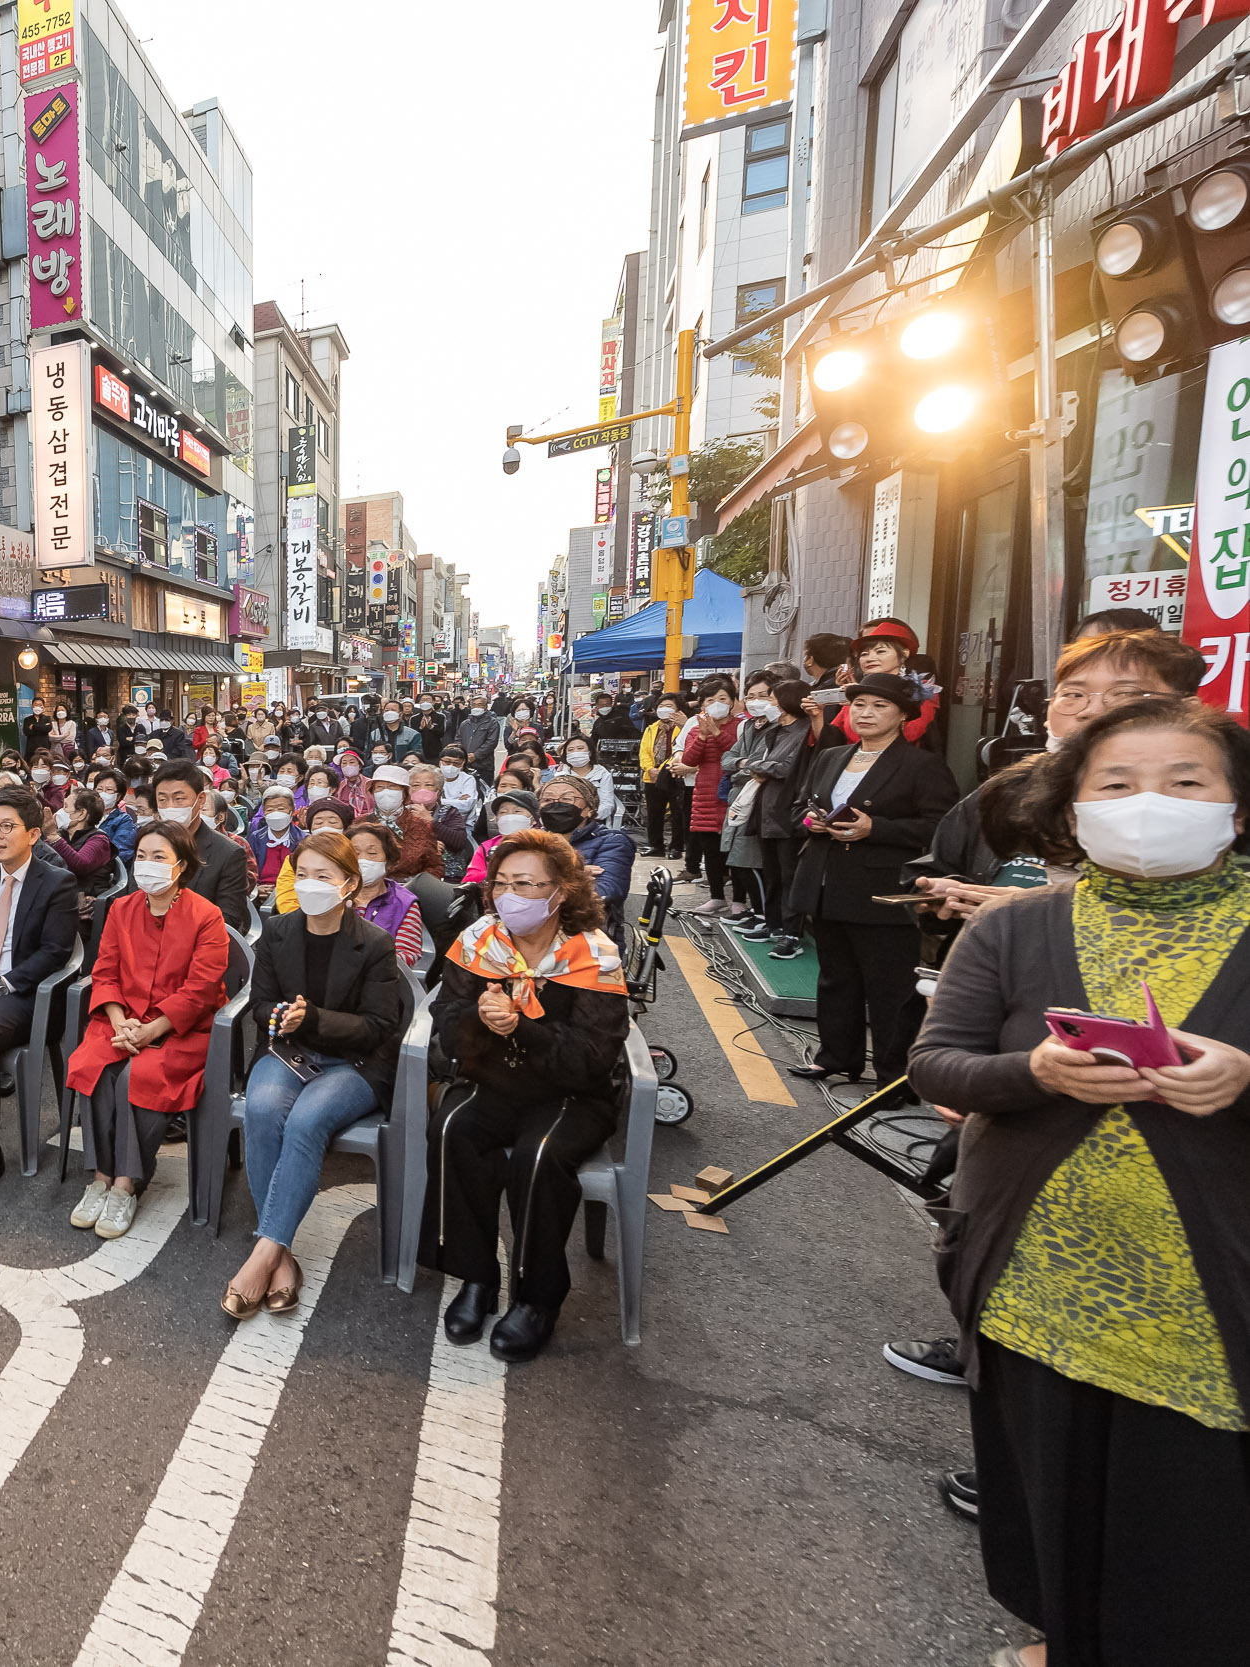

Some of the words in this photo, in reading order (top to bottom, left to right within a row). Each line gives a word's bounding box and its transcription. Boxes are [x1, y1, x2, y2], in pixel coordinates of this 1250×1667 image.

[21, 12, 71, 40] 455-7752
[22, 41, 46, 61] 국내산
[22, 58, 46, 79] 전문점
[54, 52, 67, 67] 2F
[31, 95, 68, 140] 토마토
[31, 152, 77, 298] 노래방
[601, 340, 617, 387] 마사지
[134, 393, 181, 458] 고기마루
[573, 434, 600, 449] CCTV
[601, 426, 630, 443] 작동중
[46, 361, 72, 550] 냉동삼겹전문
[1147, 506, 1196, 536] TE
[290, 539, 314, 624] 대봉갈비
